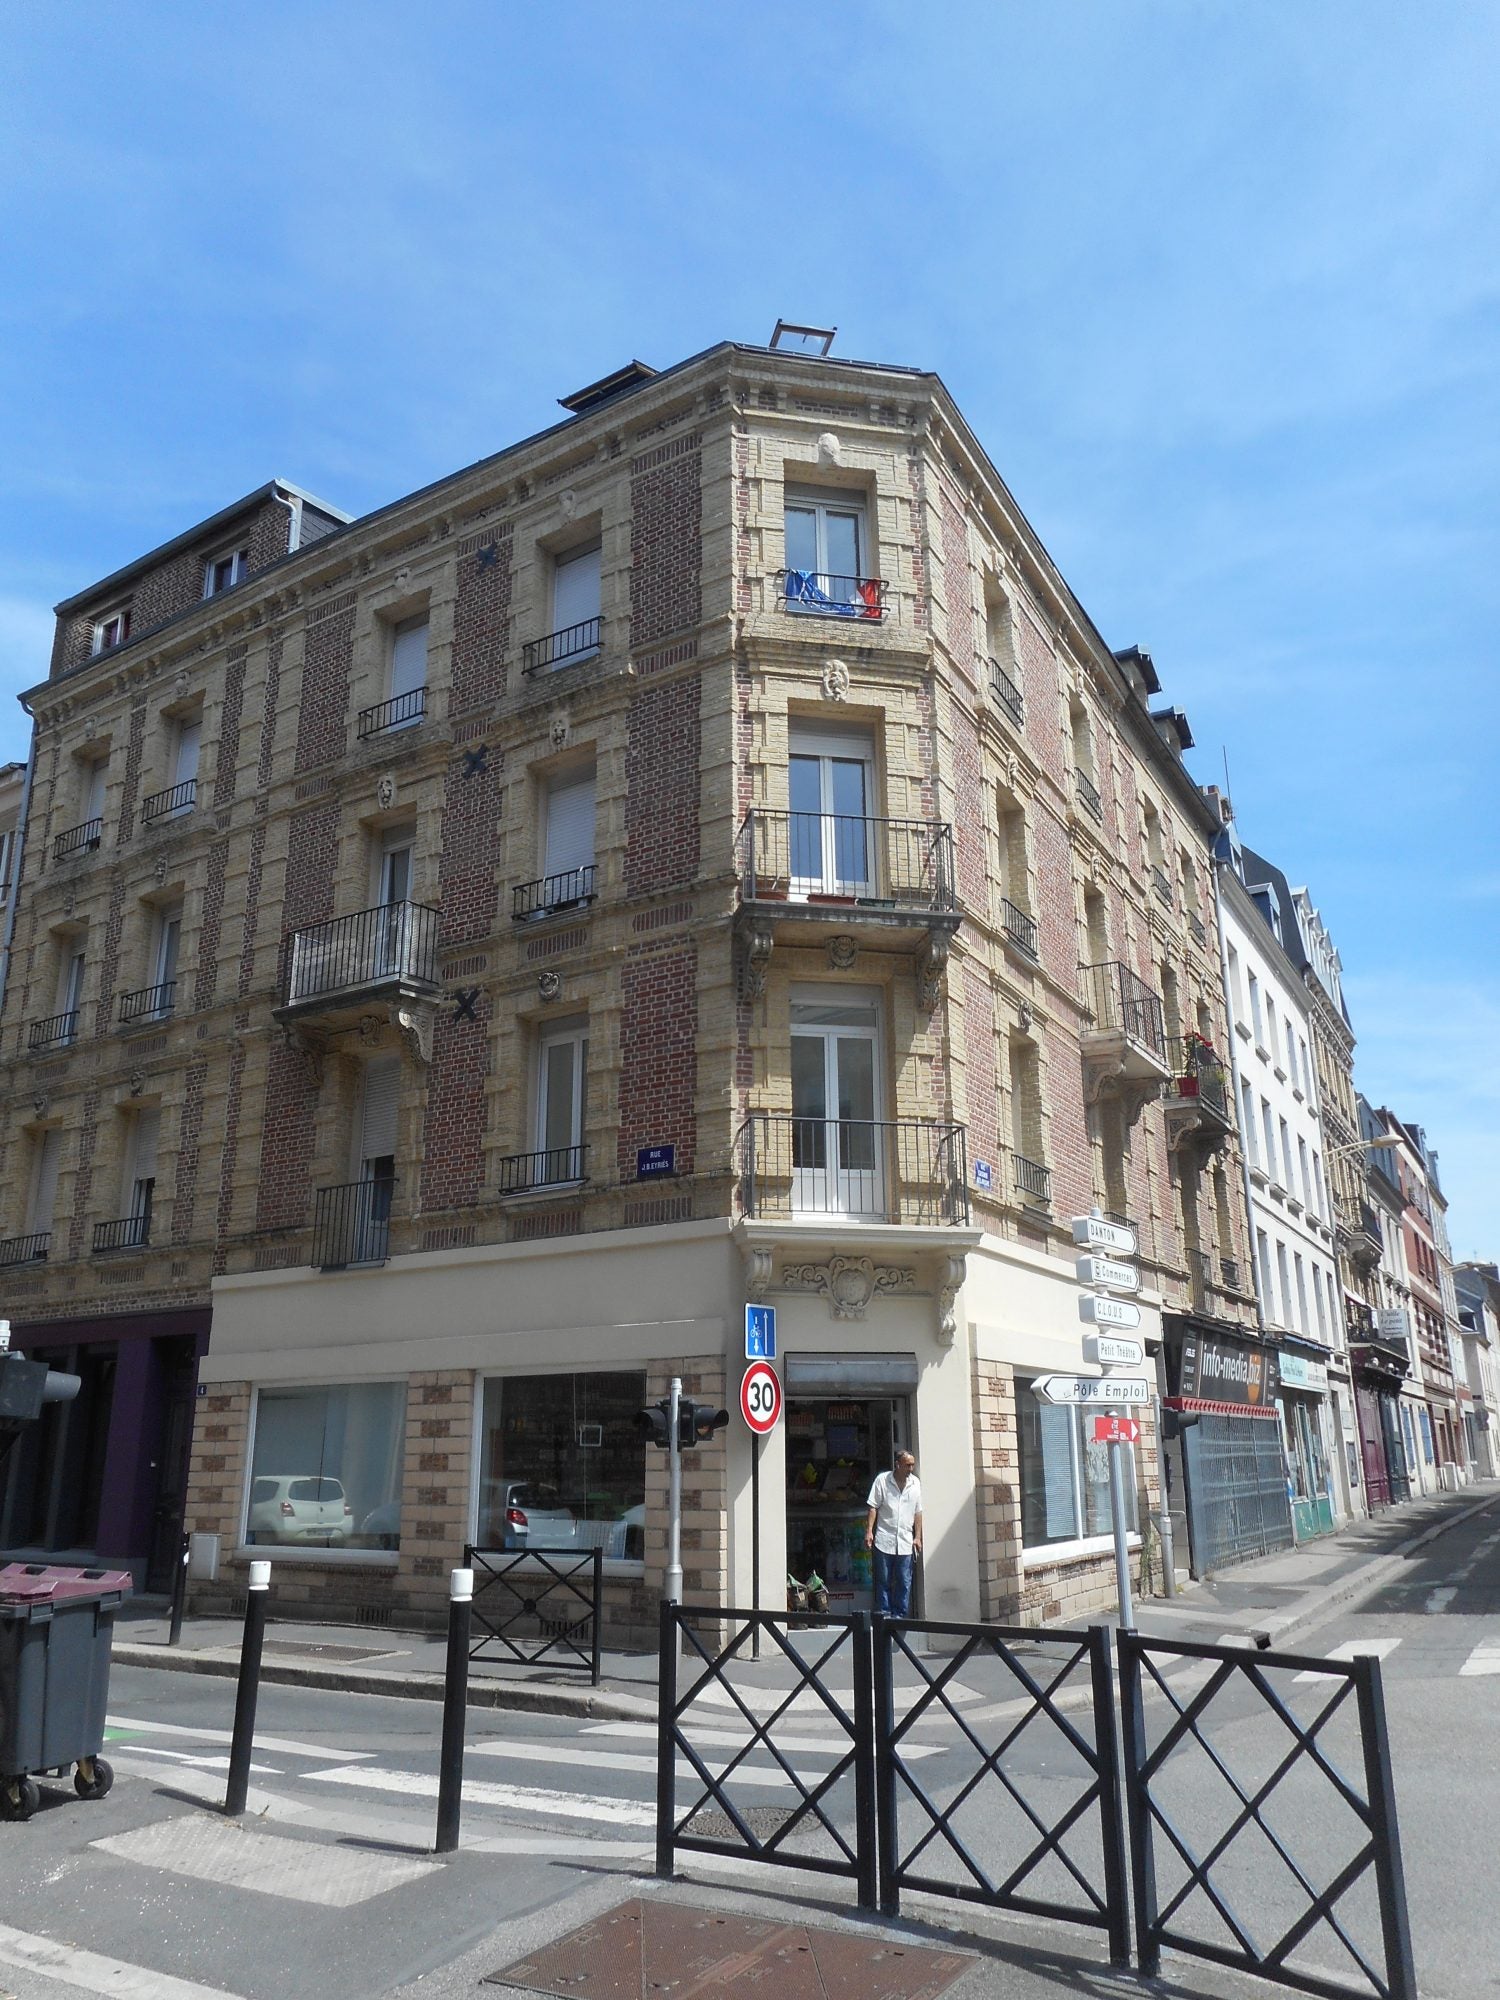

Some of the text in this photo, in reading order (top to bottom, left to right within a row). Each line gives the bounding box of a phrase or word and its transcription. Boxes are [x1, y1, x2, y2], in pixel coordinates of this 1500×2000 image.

[1090, 1224, 1115, 1242] DANTON
[1102, 1265, 1132, 1283] Commerces
[1101, 1342, 1115, 1357] Petit
[1202, 1343, 1260, 1385] info-media.biz
[750, 1382, 774, 1412] 30
[1073, 1383, 1144, 1400] Pôle Emploi
